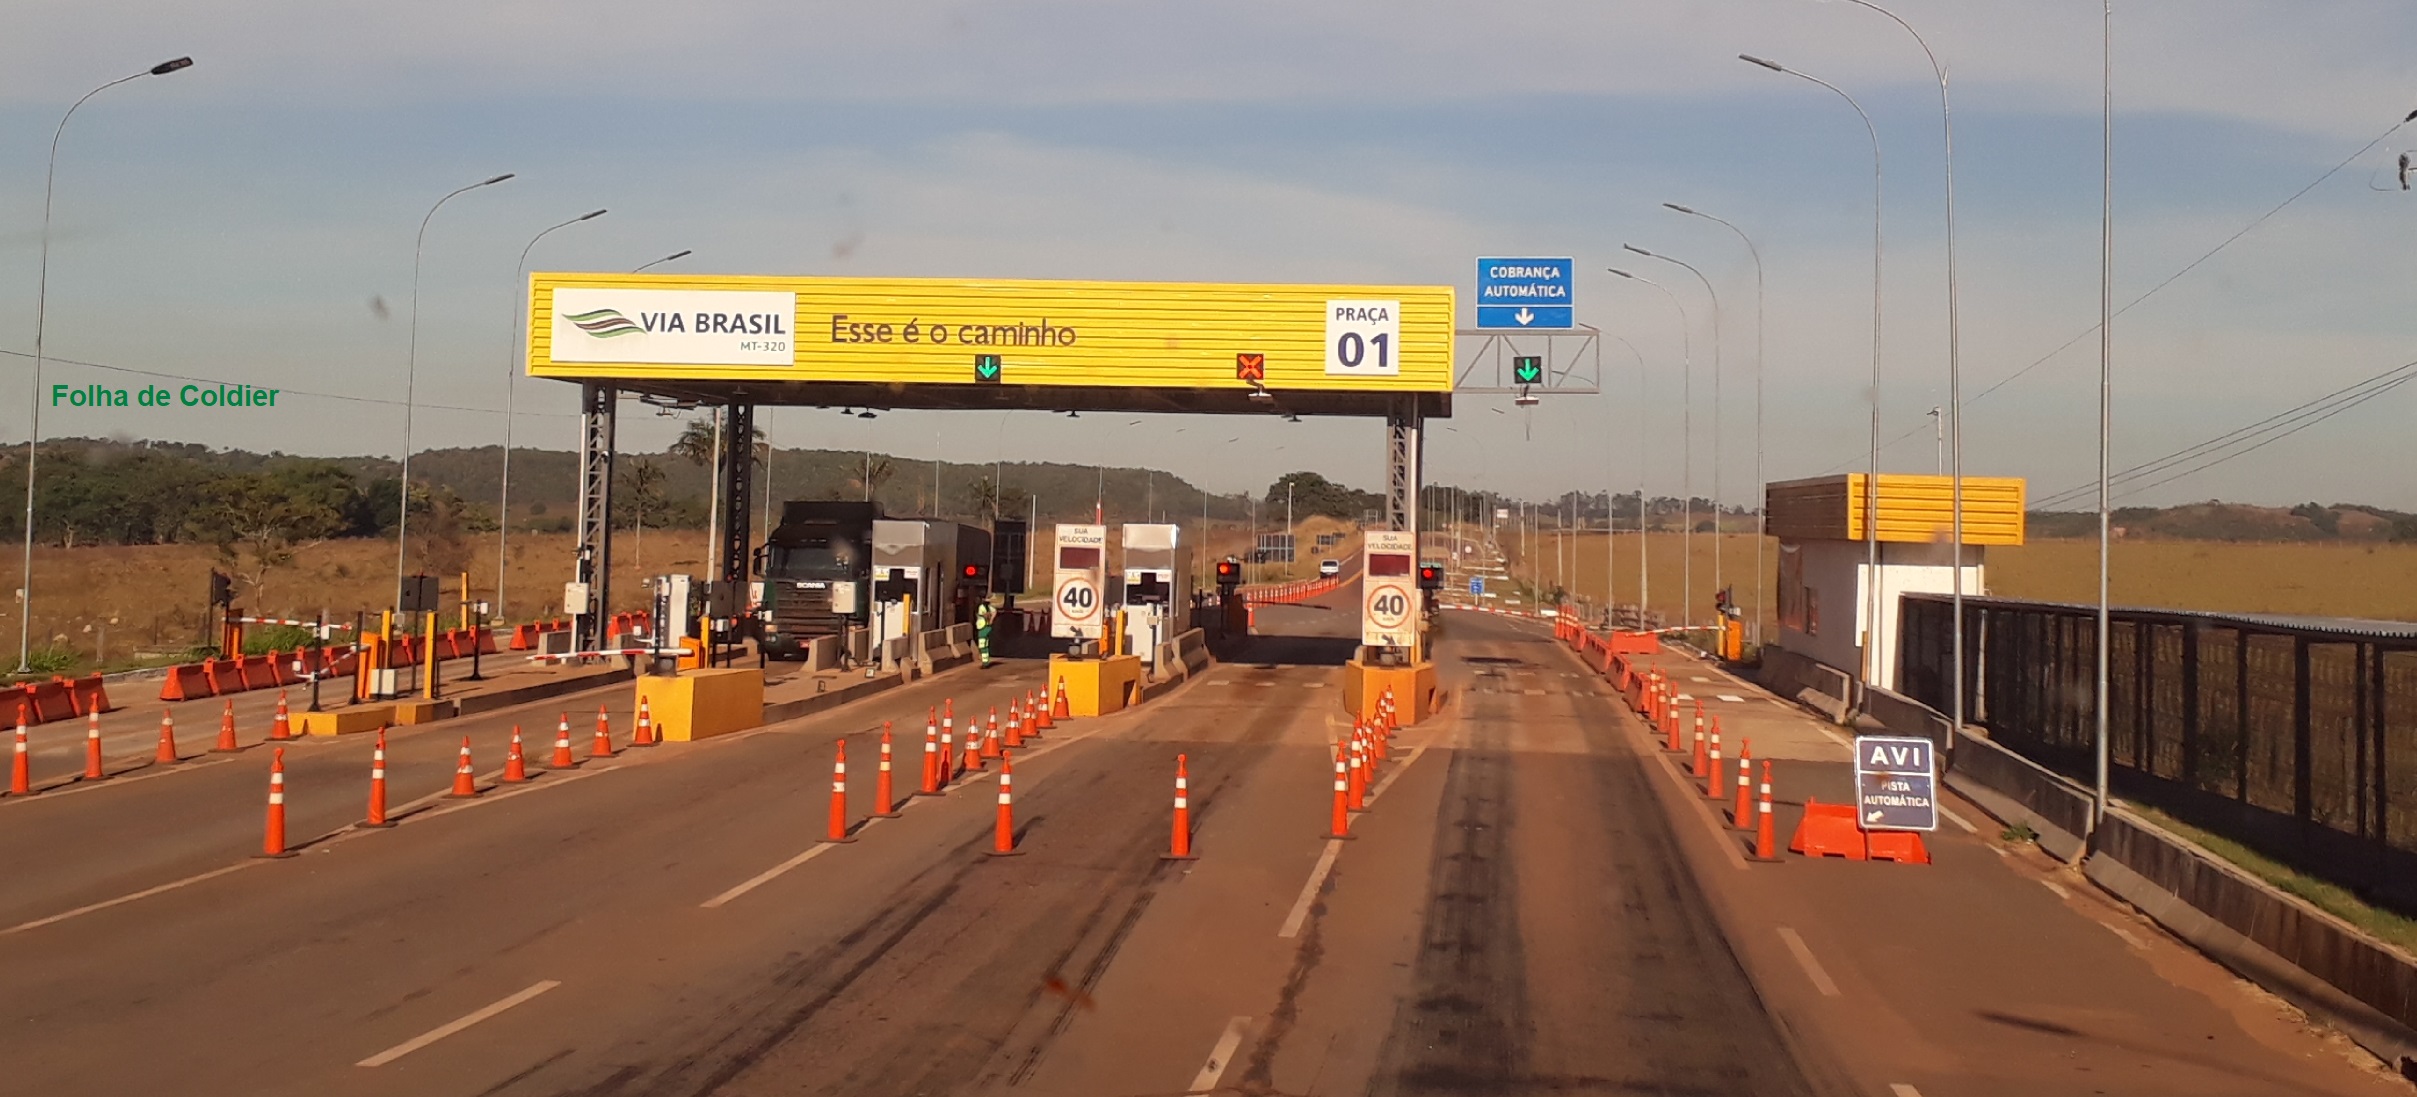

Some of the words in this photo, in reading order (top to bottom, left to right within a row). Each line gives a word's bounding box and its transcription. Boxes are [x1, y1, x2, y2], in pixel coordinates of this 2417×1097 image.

[1489, 266, 1560, 280] COBRANÇA
[1484, 283, 1566, 297] AUTOMÁTICA
[640, 312, 685, 333] VIA
[695, 312, 786, 335] BRASIL
[1335, 307, 1389, 325] PRAÇA
[831, 315, 893, 343] Esse
[902, 316, 920, 343] é
[929, 325, 948, 344] o
[958, 318, 1077, 347] caminho
[740, 340, 786, 352] MT-320
[1337, 331, 1389, 368] 01
[1063, 587, 1093, 608] 40
[1374, 595, 1404, 616] 40
[1870, 746, 1920, 766] AVI
[1881, 782, 1910, 791] PISTA
[1864, 794, 1929, 807] AUTOMÁTICA
